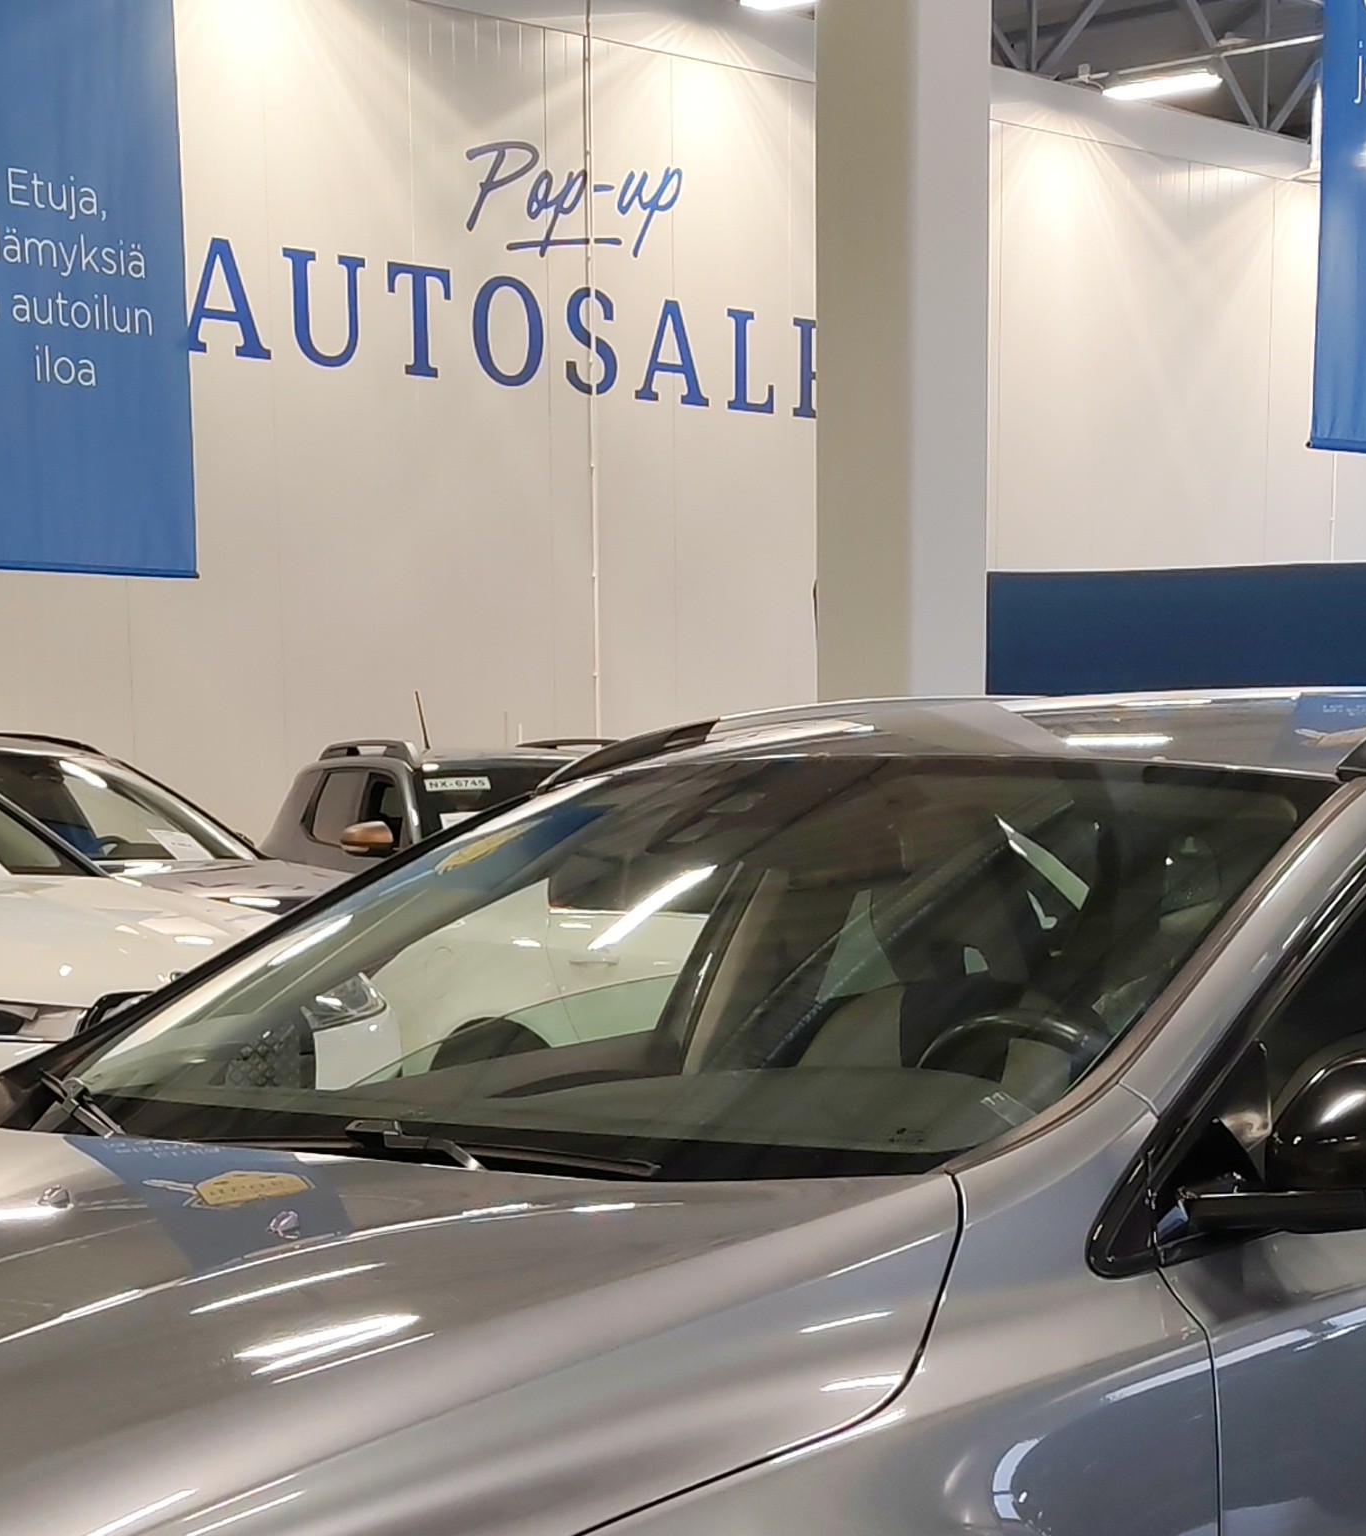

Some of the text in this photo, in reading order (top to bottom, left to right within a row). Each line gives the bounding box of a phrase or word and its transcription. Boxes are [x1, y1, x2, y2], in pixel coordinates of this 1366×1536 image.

[6, 166, 107, 221] Etuja,
[465, 140, 683, 258] Pop-up
[11, 291, 153, 336] autoilun
[35, 344, 97, 387] iloa
